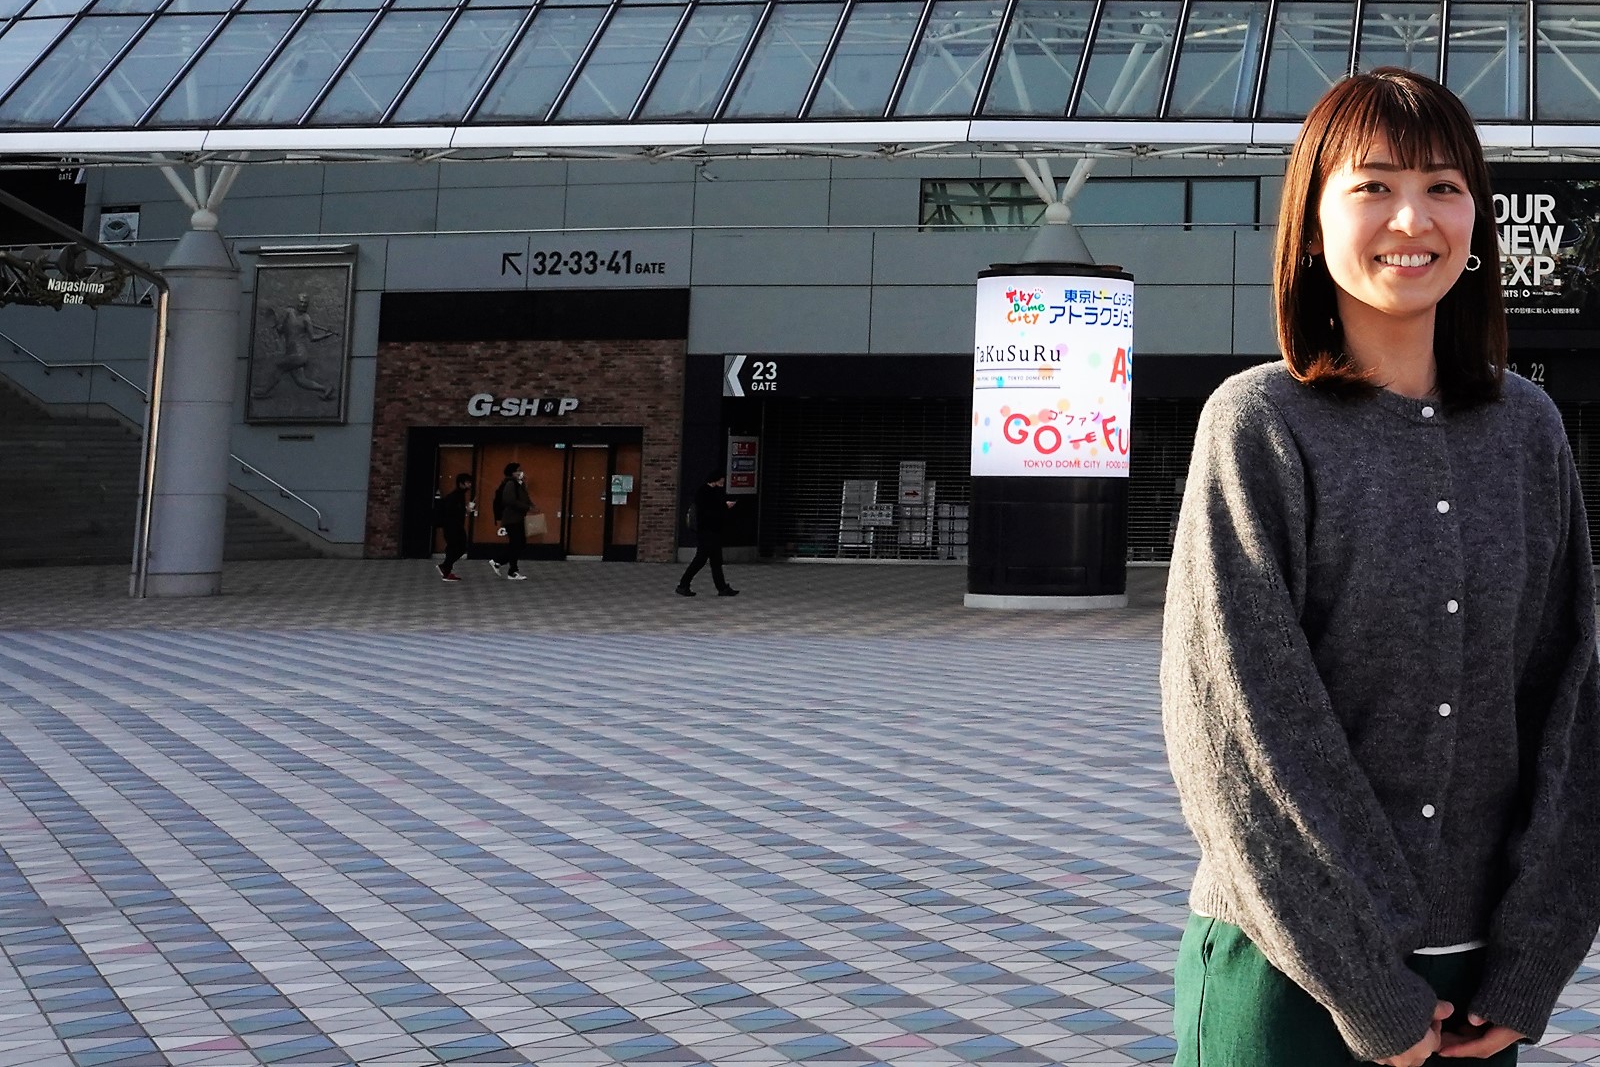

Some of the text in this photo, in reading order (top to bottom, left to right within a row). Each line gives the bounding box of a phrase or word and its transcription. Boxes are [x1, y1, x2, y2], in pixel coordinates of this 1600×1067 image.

[1497, 225, 1565, 255] NEW
[635, 262, 666, 275] GATE
[47, 278, 105, 294] Nagashima
[63, 293, 85, 305] Gate
[1006, 286, 1043, 305] Tokyo
[1502, 290, 1519, 298] NTS
[1014, 303, 1046, 313] Dome
[1007, 311, 1039, 325] City
[752, 361, 778, 380] 23
[1530, 362, 1545, 382] 22
[751, 381, 777, 391] GATE
[1003, 413, 1062, 455] GO
[1023, 459, 1053, 469] TOKYO
[1055, 459, 1081, 469] DOME
[1083, 459, 1101, 469] CITY
